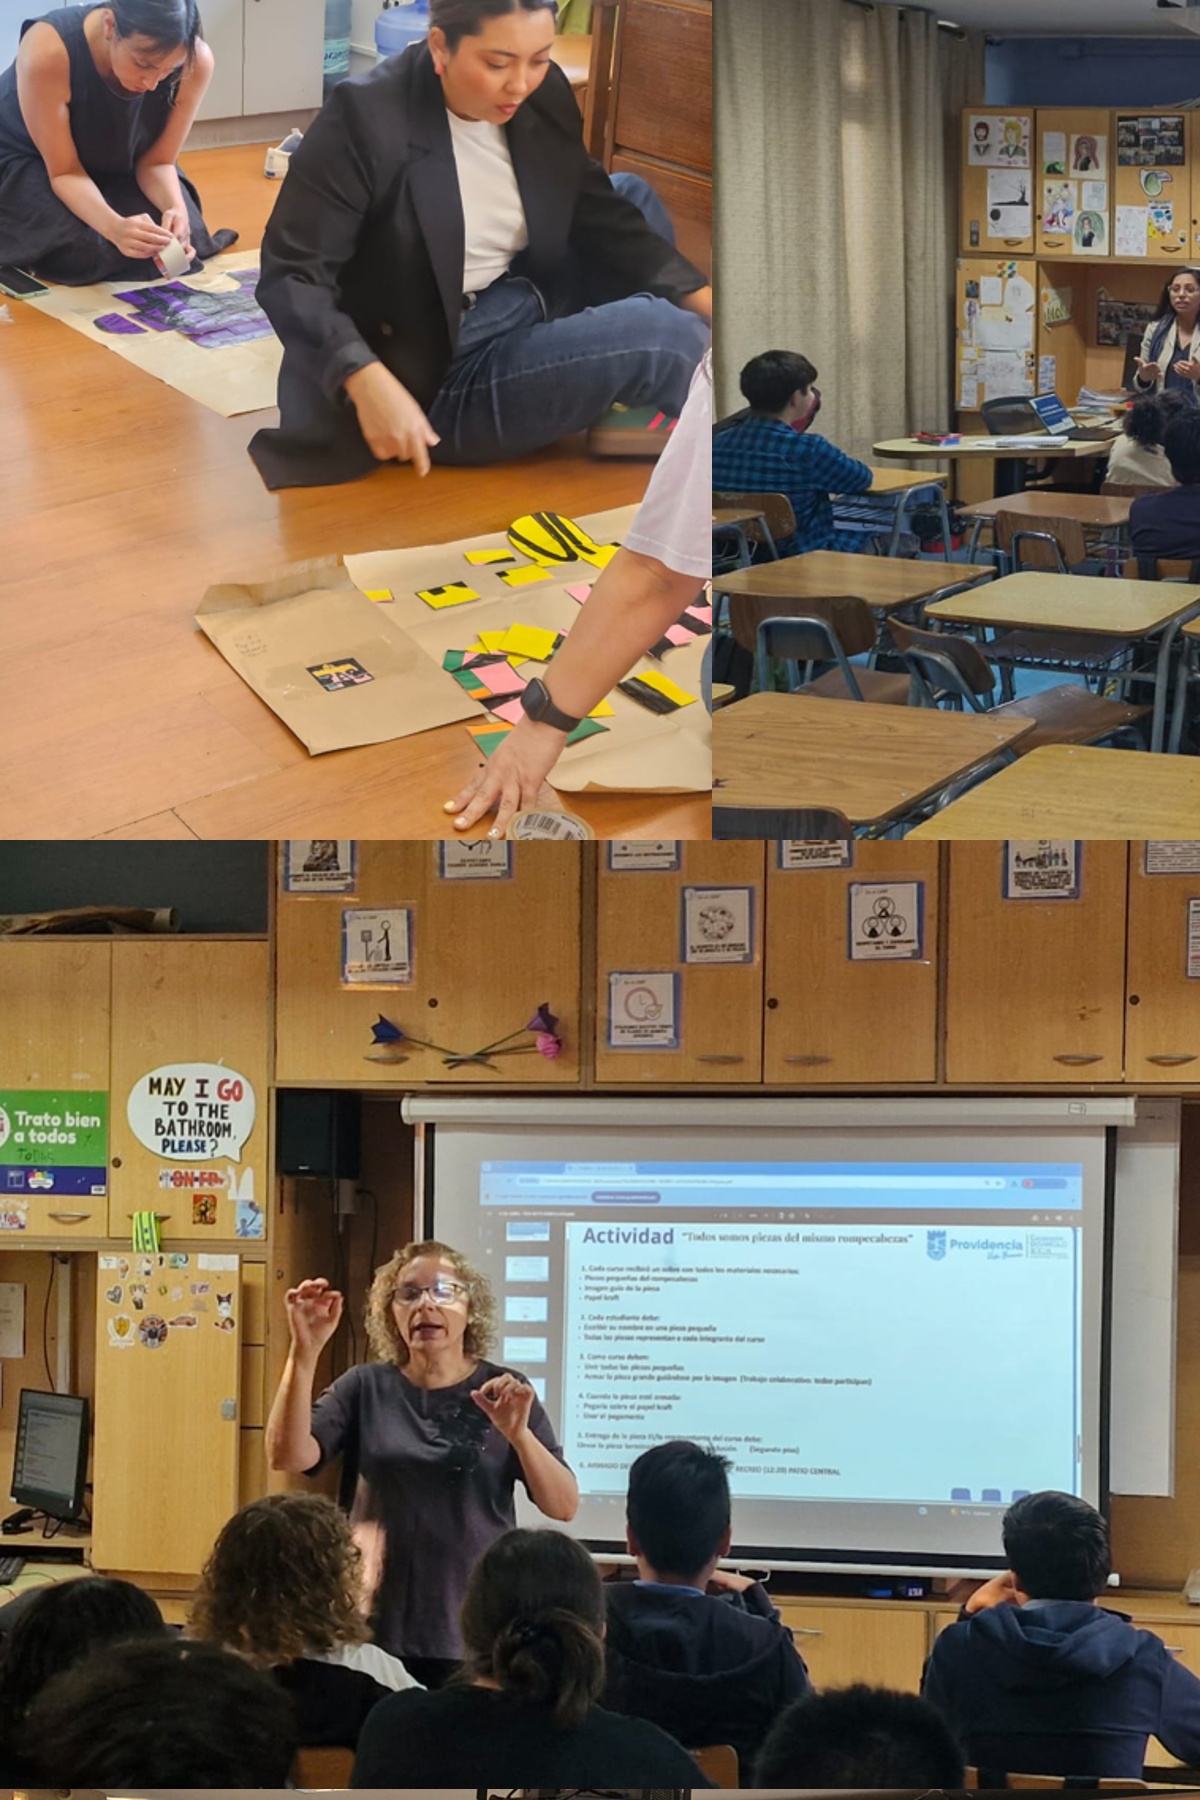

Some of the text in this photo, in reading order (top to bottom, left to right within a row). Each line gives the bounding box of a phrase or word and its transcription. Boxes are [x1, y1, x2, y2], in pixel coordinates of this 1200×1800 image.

[149, 1077, 243, 1102] MAY I GO
[15, 1111, 101, 1128] Trato bien
[163, 1100, 229, 1121] TO THE
[14, 1129, 77, 1144] a todos
[155, 1117, 237, 1141] BATHROOM,
[583, 1227, 674, 1245] Actividad
[719, 1233, 750, 1242] somos
[752, 1232, 782, 1244] piezas
[784, 1233, 800, 1243] del
[802, 1234, 836, 1243] mismo
[949, 1239, 1023, 1251] Providencia
